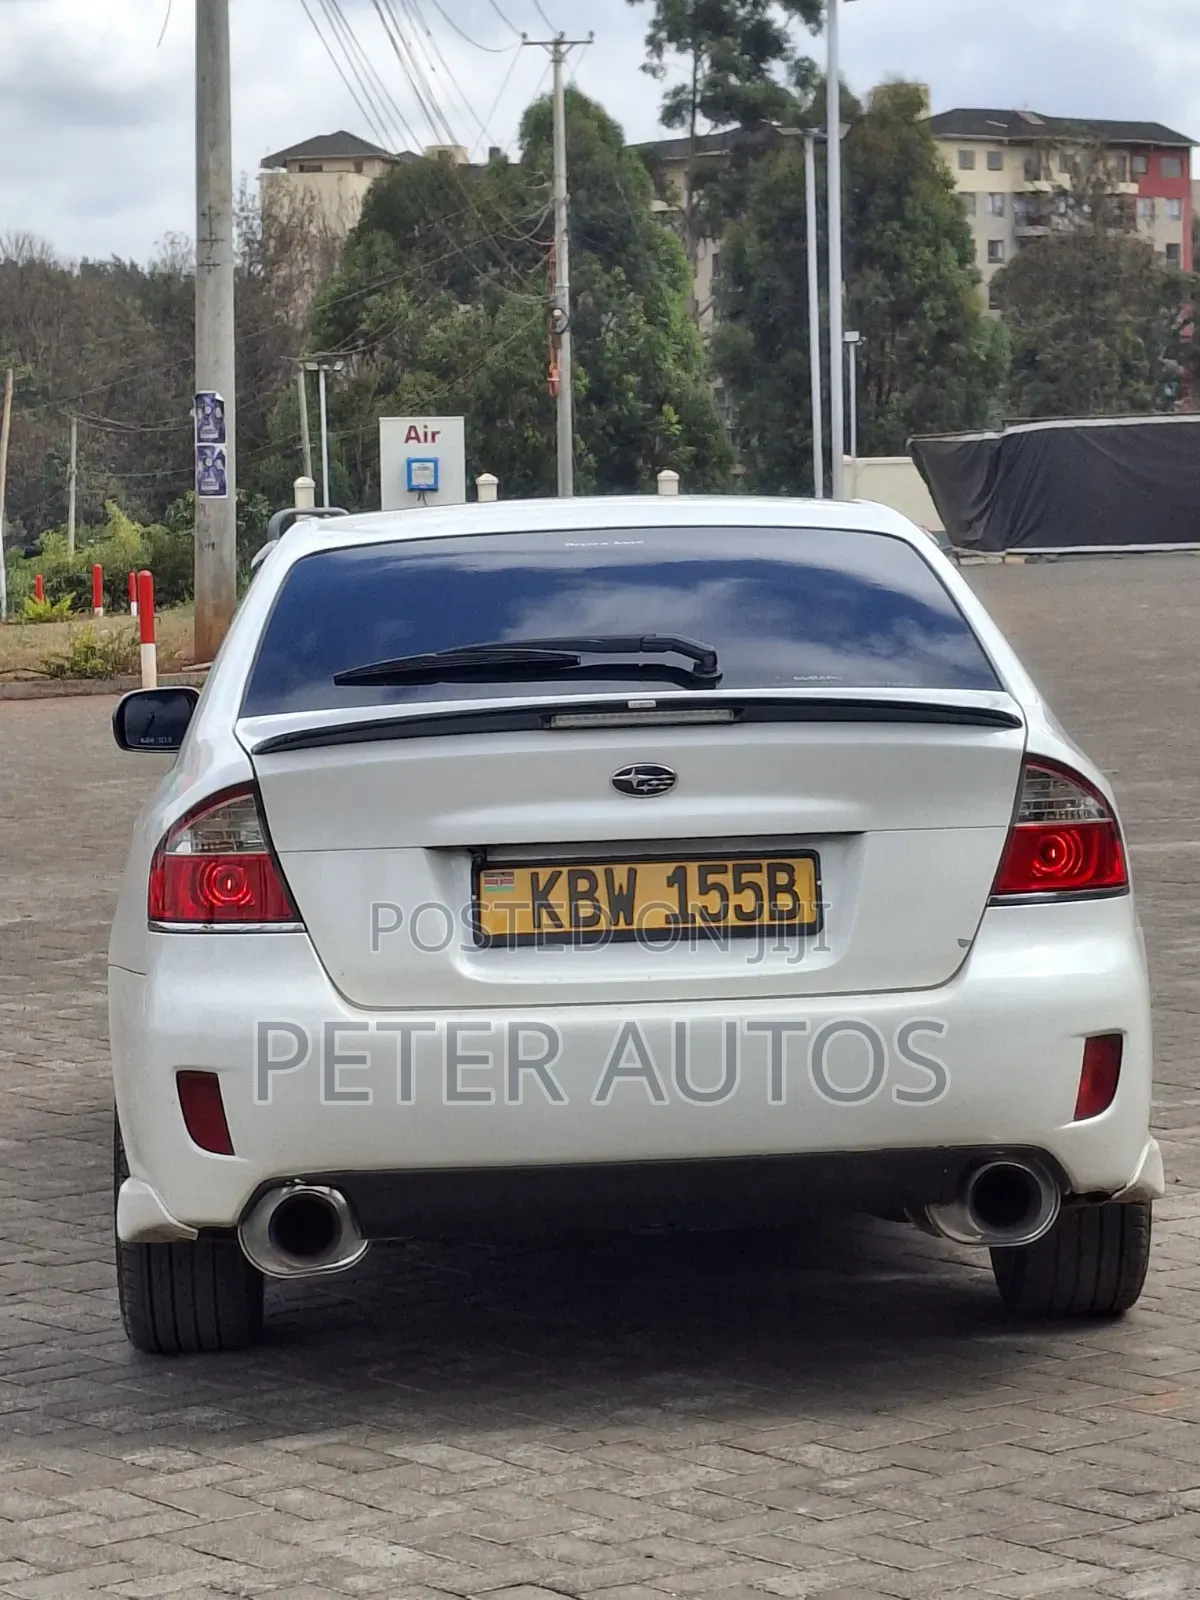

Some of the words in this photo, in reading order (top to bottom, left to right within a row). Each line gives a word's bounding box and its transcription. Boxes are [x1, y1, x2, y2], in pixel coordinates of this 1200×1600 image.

[404, 424, 441, 444] Air
[530, 867, 637, 929] KBW
[665, 862, 801, 926] 155B
